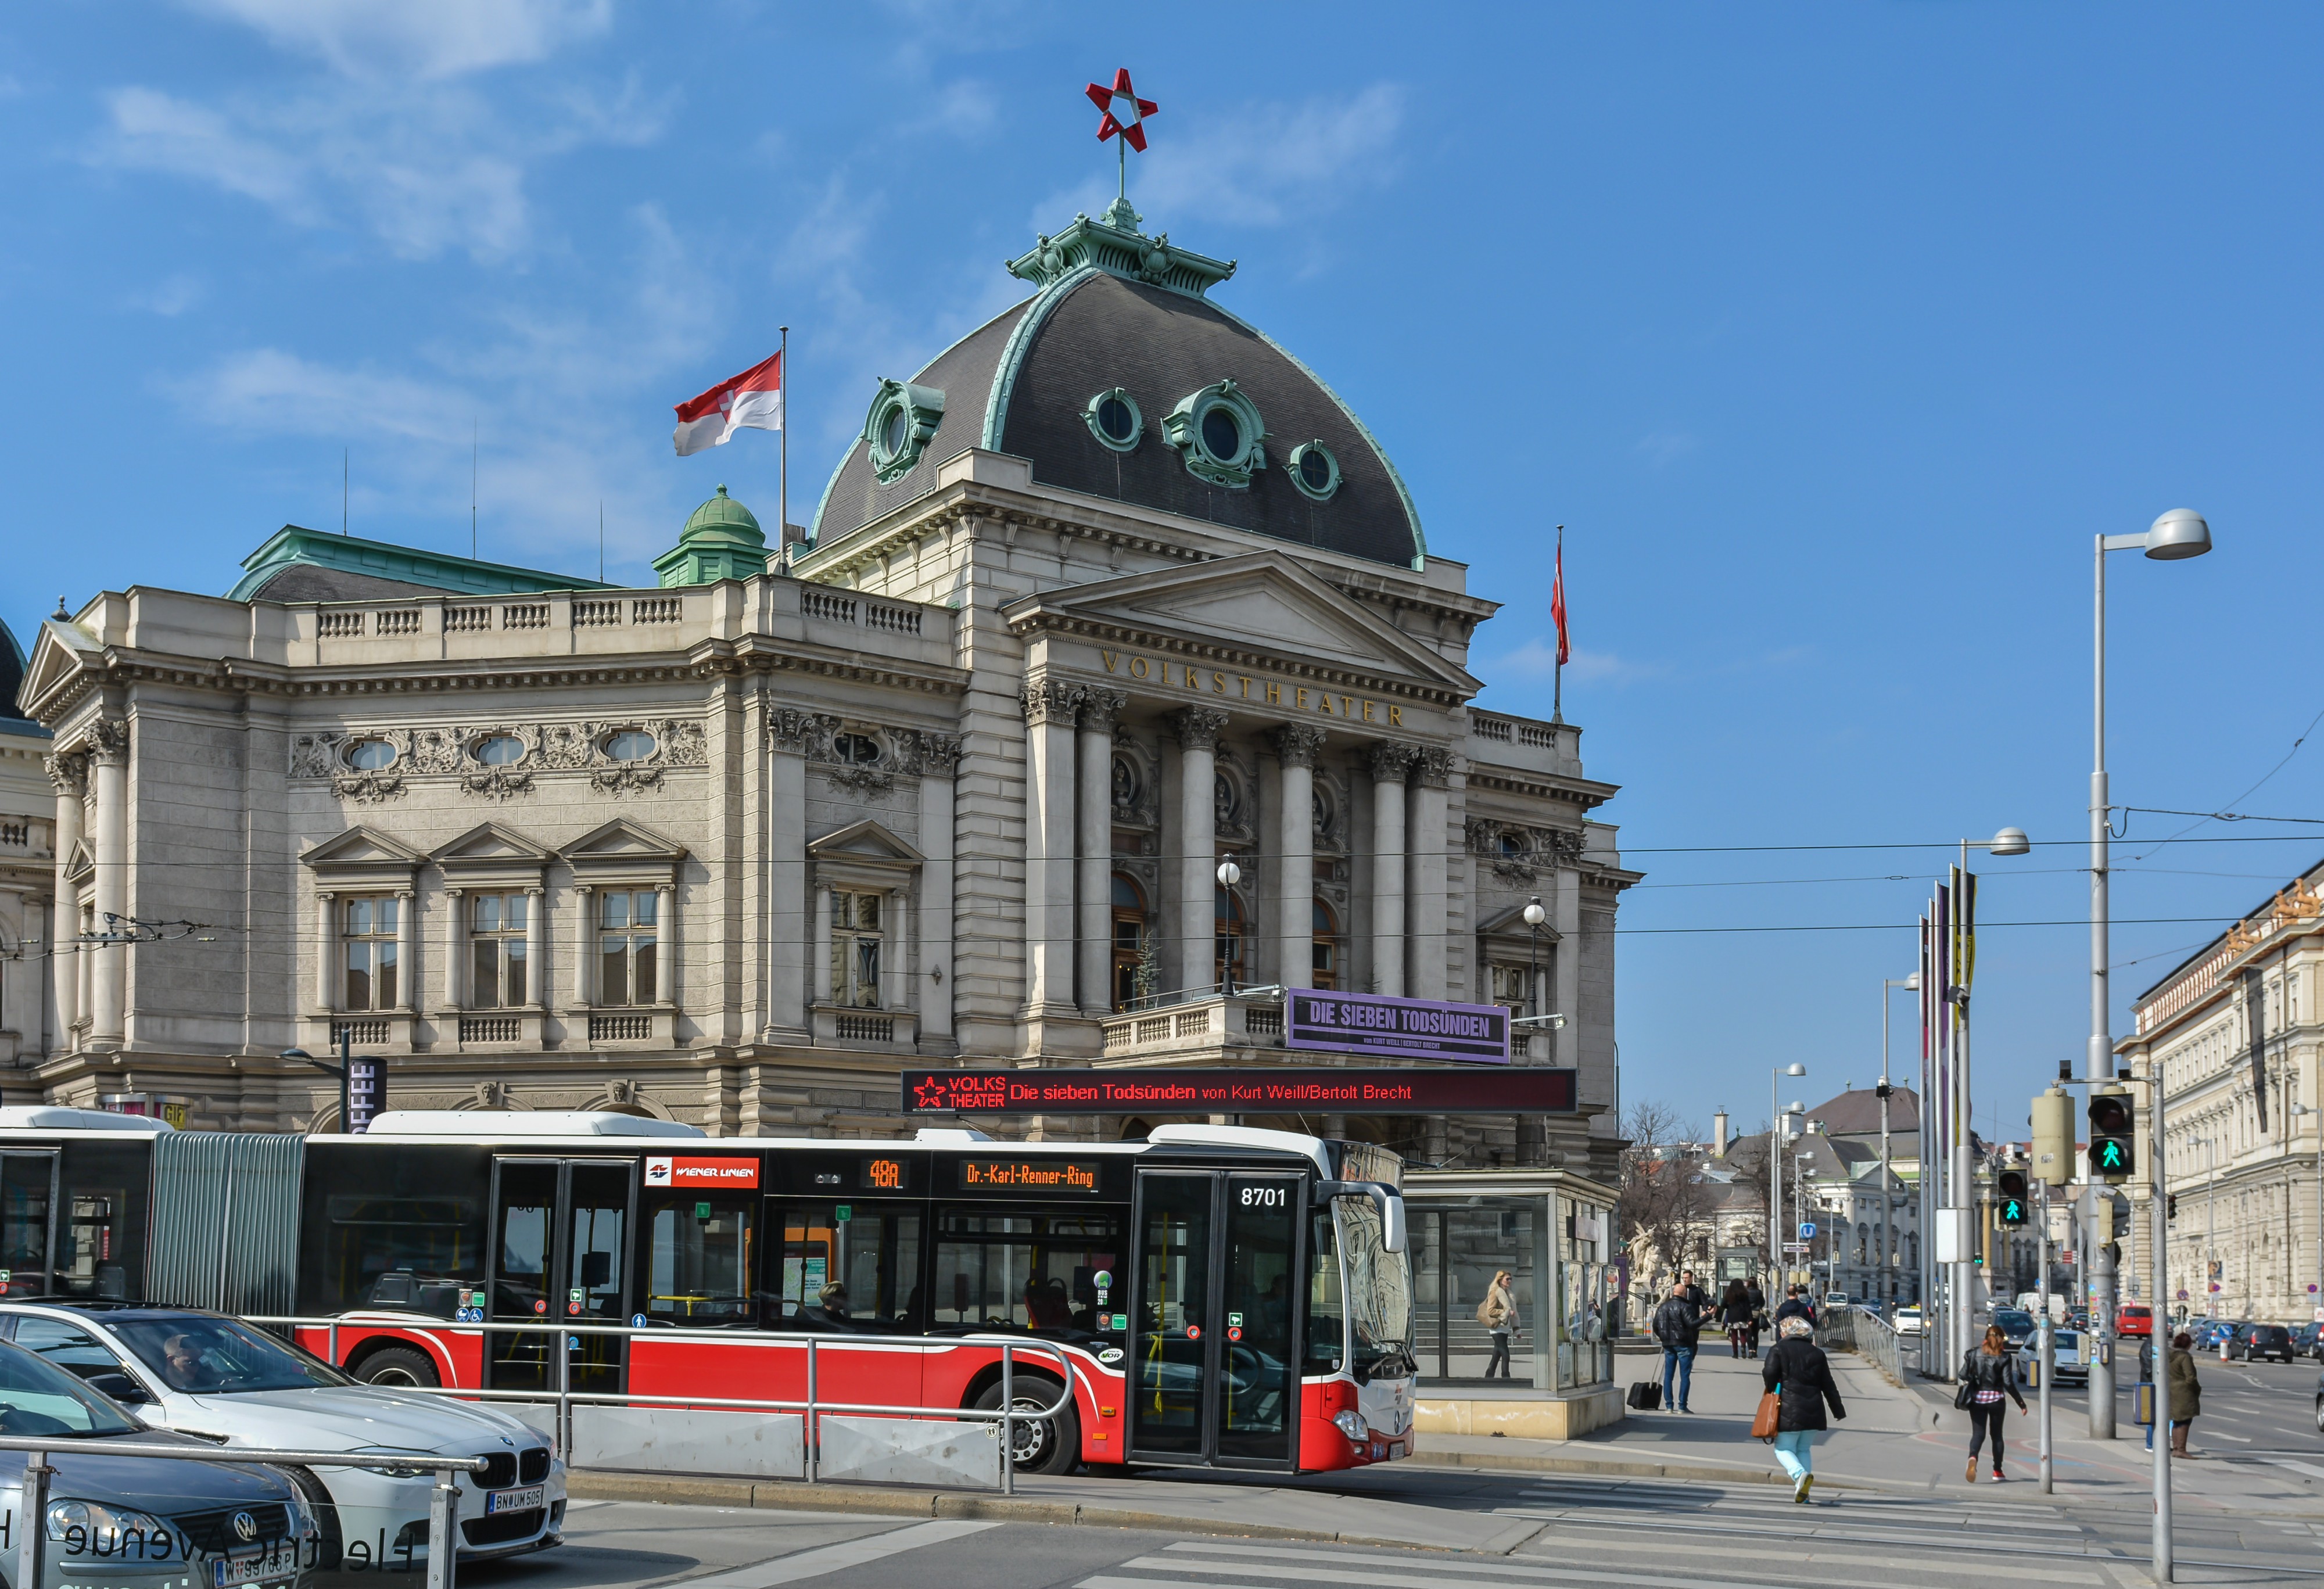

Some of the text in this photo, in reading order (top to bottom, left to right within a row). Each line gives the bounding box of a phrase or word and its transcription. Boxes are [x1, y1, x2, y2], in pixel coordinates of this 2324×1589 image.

[1103, 650, 1403, 727] VOLKSTHEATER
[1310, 1000, 1489, 1038] DIE SIEBEN TODSÜNDEN
[1403, 1040, 1422, 1048] BERTOLT
[1423, 1042, 1440, 1050] BRECHT
[948, 1076, 1006, 1091] VOLKS
[1010, 1084, 1412, 1100] Die sieben Todsünden von Kurt Weill/Bertolt Brecht
[948, 1093, 1005, 1107] THEATER
[676, 1167, 754, 1177] WIENER LINIEN
[870, 1160, 899, 1186] 48A
[967, 1164, 1093, 1188] Dr.-Karl-Renner-Ring
[1241, 1188, 1285, 1206] 8701
[1803, 1226, 1813, 1238] U
[496, 1494, 508, 1509] BN
[514, 1492, 525, 1508] UM
[526, 1490, 540, 1506] 505
[225, 1562, 234, 1581] W
